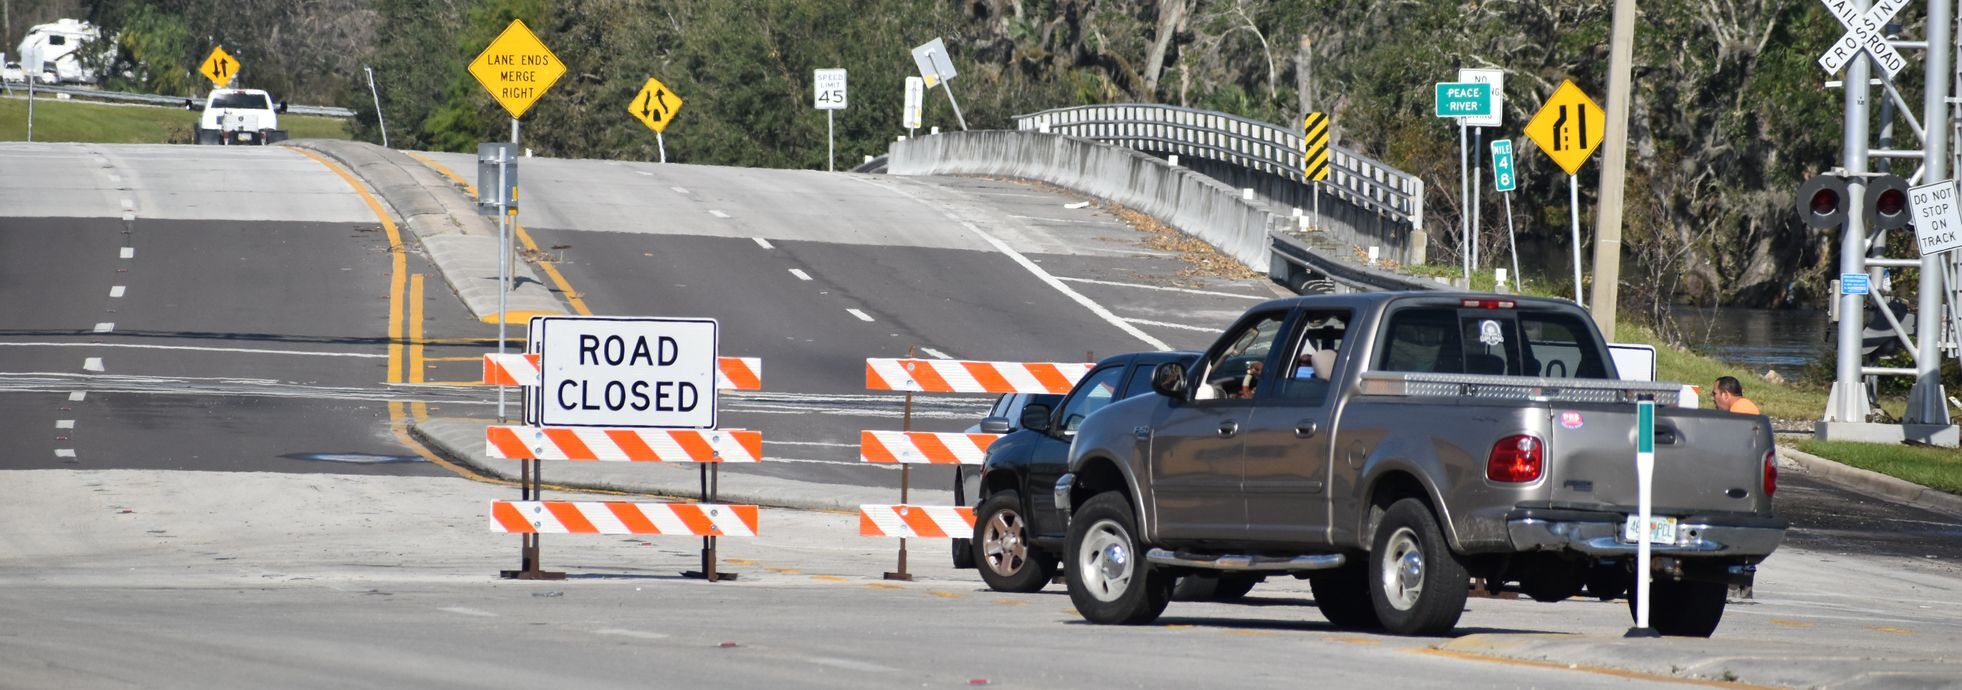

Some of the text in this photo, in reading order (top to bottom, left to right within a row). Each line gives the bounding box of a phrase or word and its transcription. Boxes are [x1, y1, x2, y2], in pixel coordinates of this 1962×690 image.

[1828, 0, 1900, 71] AIL ROAD
[487, 54, 549, 66] LANE ENDS
[500, 70, 536, 82] MERGE
[1474, 75, 1488, 83] NO
[502, 87, 534, 99] RIGHT
[818, 90, 844, 104] 45
[1447, 88, 1479, 98] PEACE
[1449, 101, 1478, 111] RIVER
[1493, 145, 1510, 155] MILE
[1913, 188, 1951, 205] DO NOT
[1922, 203, 1949, 218] STOP
[1931, 218, 1947, 231] ON
[1921, 231, 1957, 247] TRACK
[579, 334, 678, 366] ROAD
[557, 379, 699, 412] CLOSED
